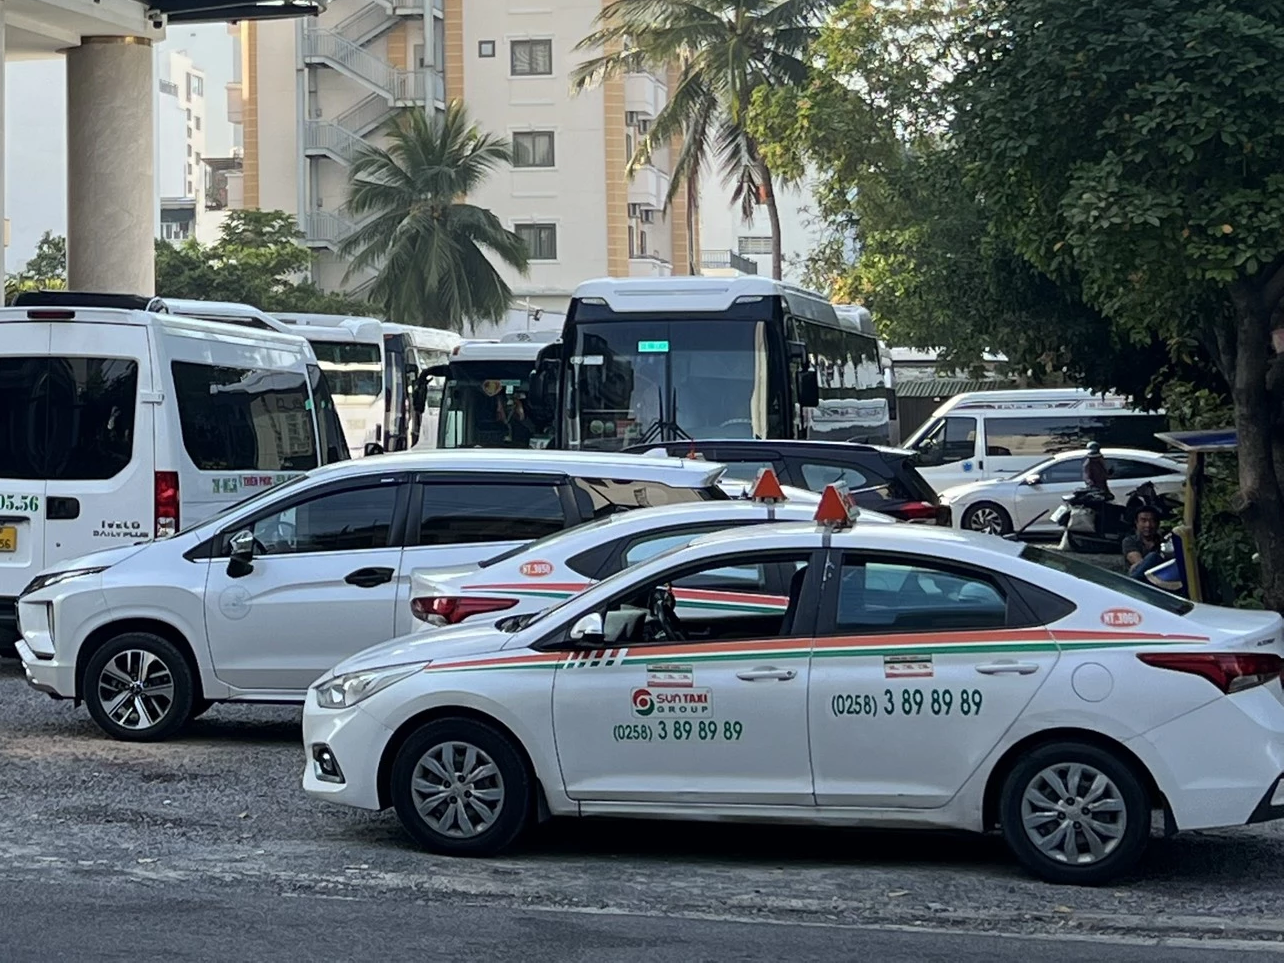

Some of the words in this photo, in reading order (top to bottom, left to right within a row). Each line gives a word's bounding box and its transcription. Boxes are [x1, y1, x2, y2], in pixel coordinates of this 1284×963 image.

[684, 693, 708, 704] TAXI
[831, 695, 878, 718] (0258)
[884, 689, 895, 715] 3
[902, 689, 924, 716] 89
[931, 689, 953, 716] 89
[960, 689, 983, 716] 89
[656, 705, 708, 713] GROUP
[613, 724, 653, 742] (0258)
[658, 720, 668, 741] 3
[673, 720, 693, 741] 89
[698, 720, 718, 741] 89
[723, 720, 743, 741] 89
